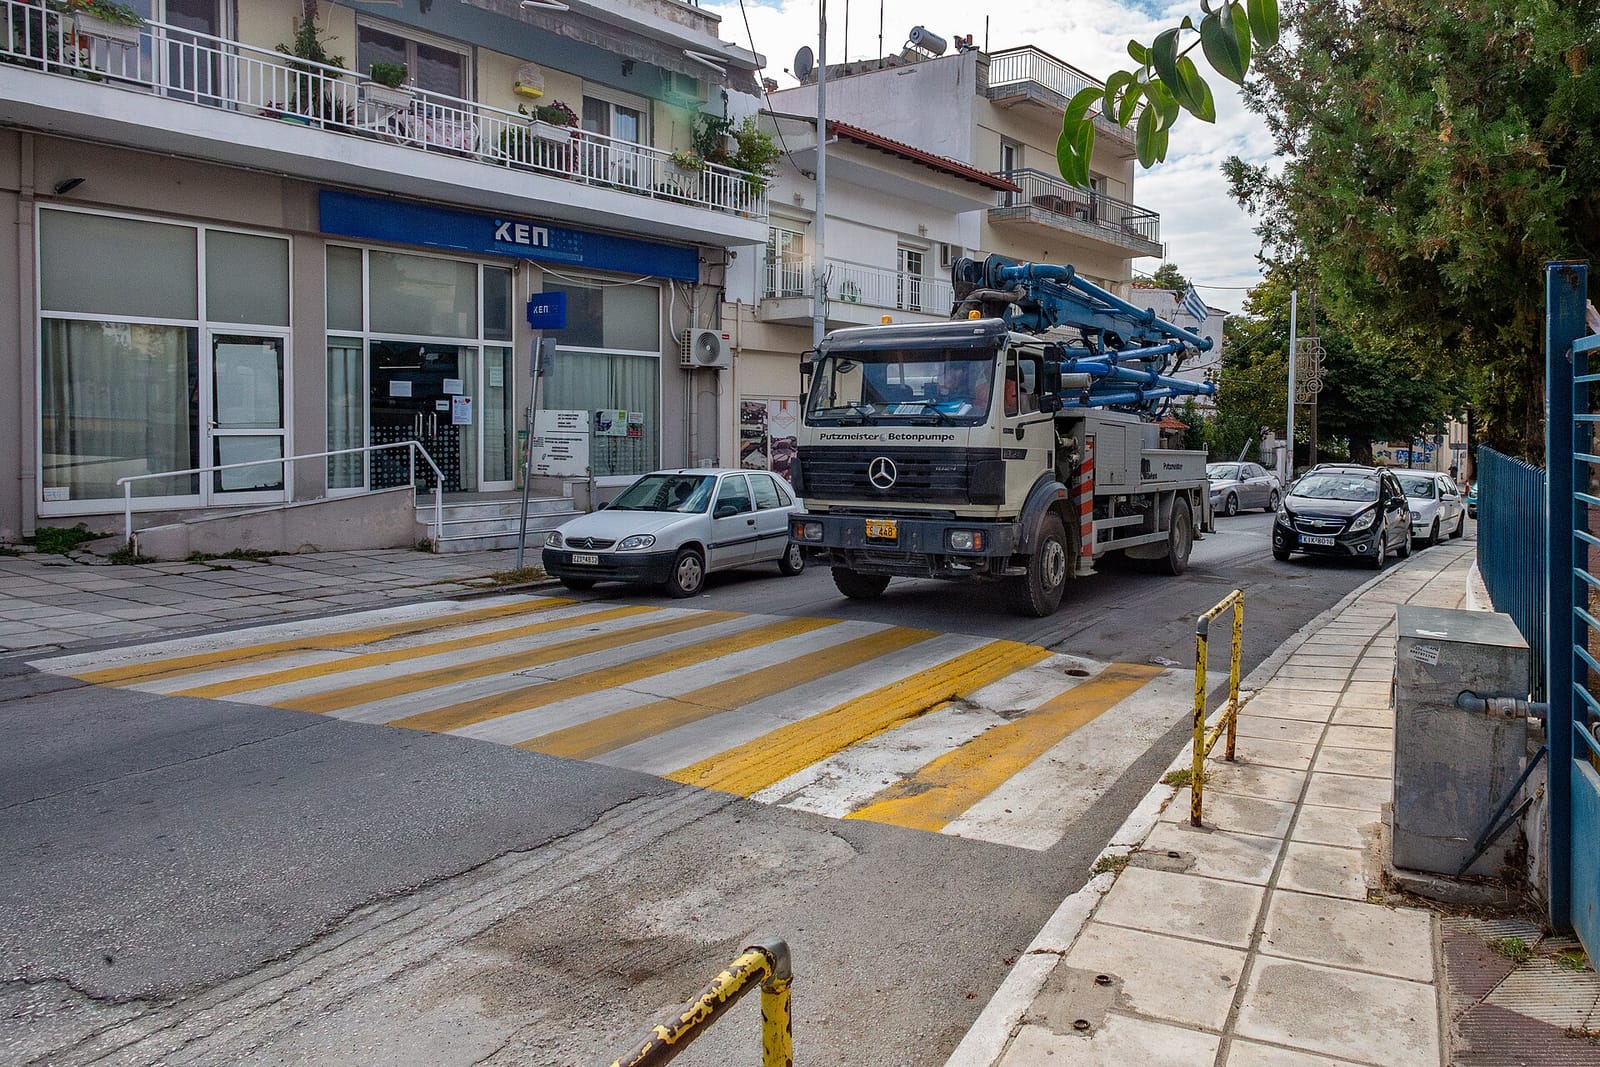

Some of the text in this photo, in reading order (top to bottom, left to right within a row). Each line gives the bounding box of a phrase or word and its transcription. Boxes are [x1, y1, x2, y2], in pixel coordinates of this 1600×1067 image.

[495, 220, 549, 247] ΚΕΠ
[533, 305, 549, 314] ΚΕΠ
[819, 432, 955, 443] Putzmeister Betonpumpe
